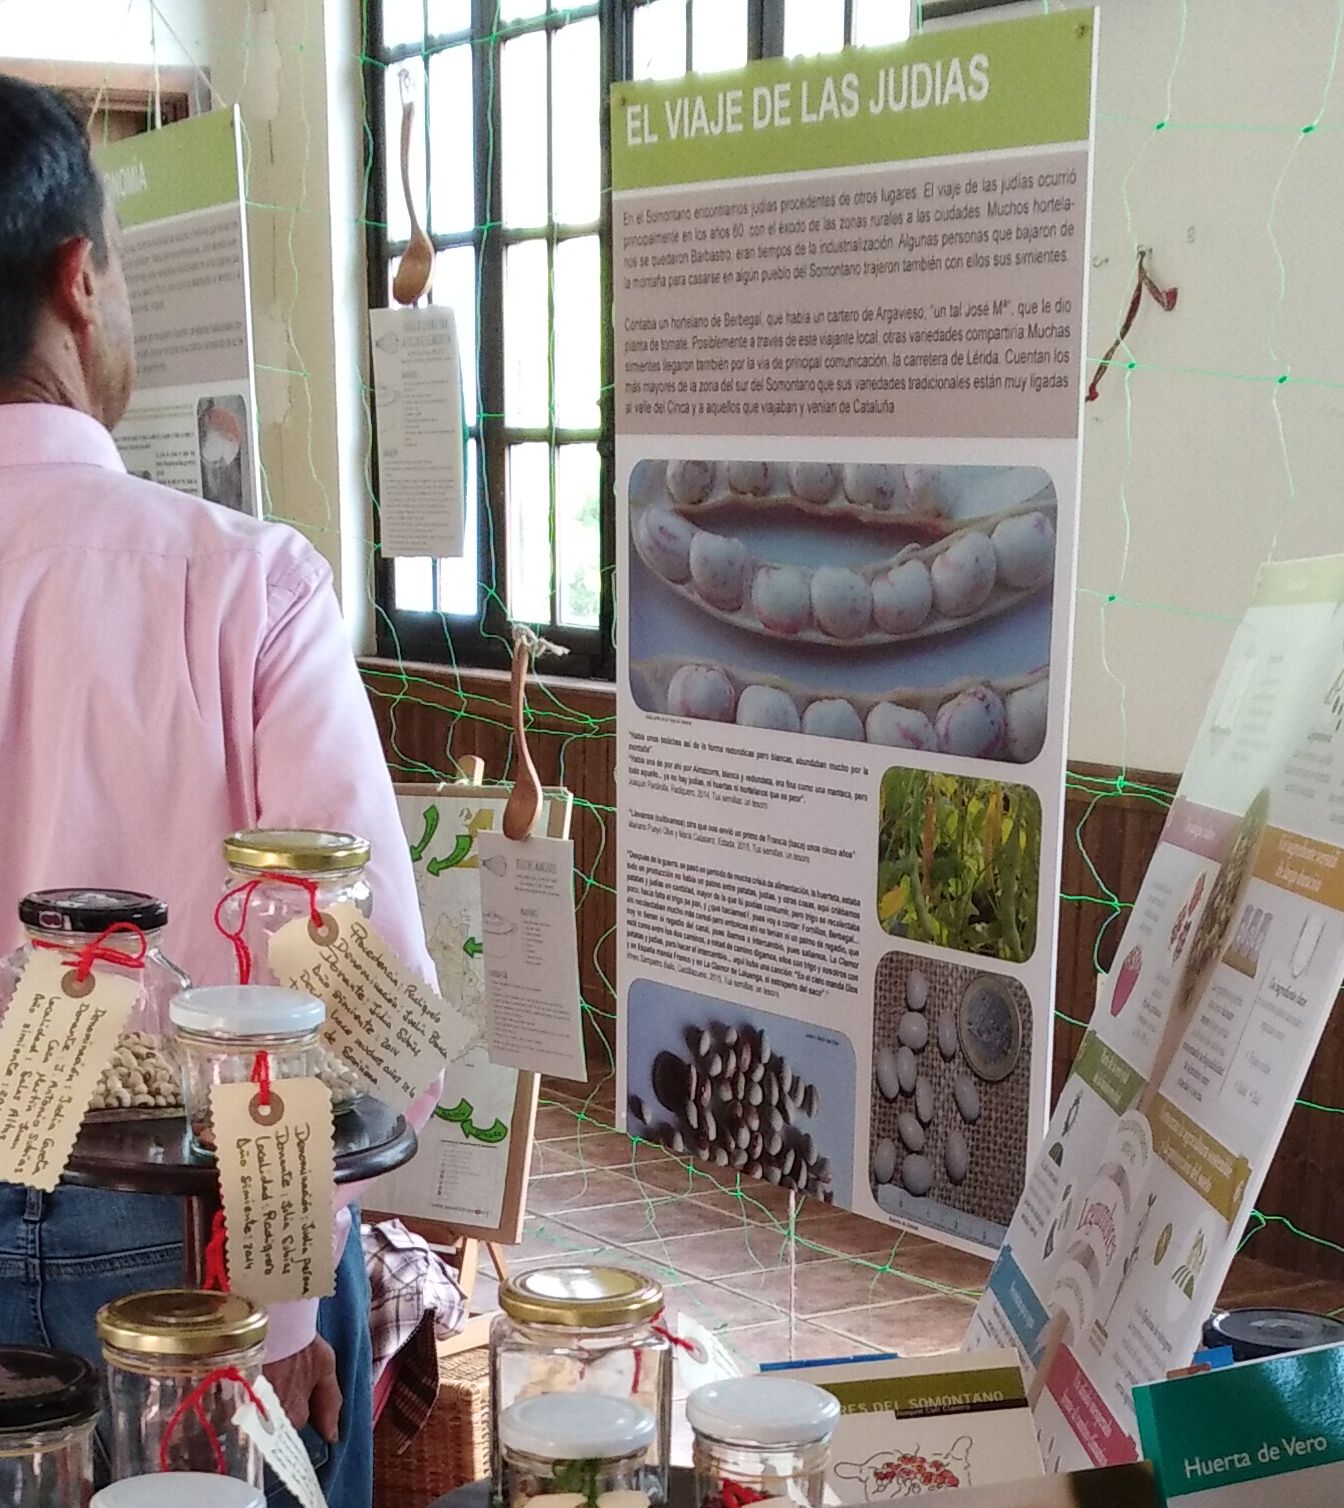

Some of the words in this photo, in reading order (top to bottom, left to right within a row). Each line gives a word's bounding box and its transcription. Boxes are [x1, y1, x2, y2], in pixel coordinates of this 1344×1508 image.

[626, 102, 657, 145] EL
[664, 89, 743, 139] VIAJE
[752, 82, 792, 128] DE
[800, 73, 859, 123] LAS
[869, 52, 990, 114] JUDIAS
[854, 189, 877, 205] otros
[924, 182, 933, 199] El
[937, 181, 960, 200] viaje
[965, 178, 977, 195] de
[982, 176, 997, 194] las
[1001, 173, 1033, 195] judías
[1037, 170, 1076, 189] ocurrió
[987, 198, 1029, 218] Muchos
[898, 231, 938, 252] Algunas
[941, 231, 988, 249] personas
[992, 230, 1011, 245] que
[1015, 222, 1056, 244] bajaron
[1060, 221, 1074, 238] de
[945, 258, 962, 270] con
[966, 252, 990, 269] ellos
[992, 255, 1010, 267] sus
[862, 306, 873, 321] de
[949, 302, 961, 318] tal
[1017, 303, 1037, 318] que
[1028, 323, 1070, 340] Muchas
[903, 351, 947, 366] carretera
[951, 350, 963, 365] de
[1005, 348, 1049, 364] Cuentan
[1053, 347, 1069, 363] los
[817, 380, 833, 393] que
[837, 380, 851, 390] sus
[973, 375, 1001, 389] están
[1004, 377, 1026, 391] muy
[1029, 373, 1068, 391] ligadas
[839, 399, 850, 413] de
[908, 1390, 1005, 1410] SOMONTANO
[1184, 1450, 1252, 1479] Huerta
[1258, 1441, 1281, 1463] de
[1282, 1434, 1328, 1457] Vero
